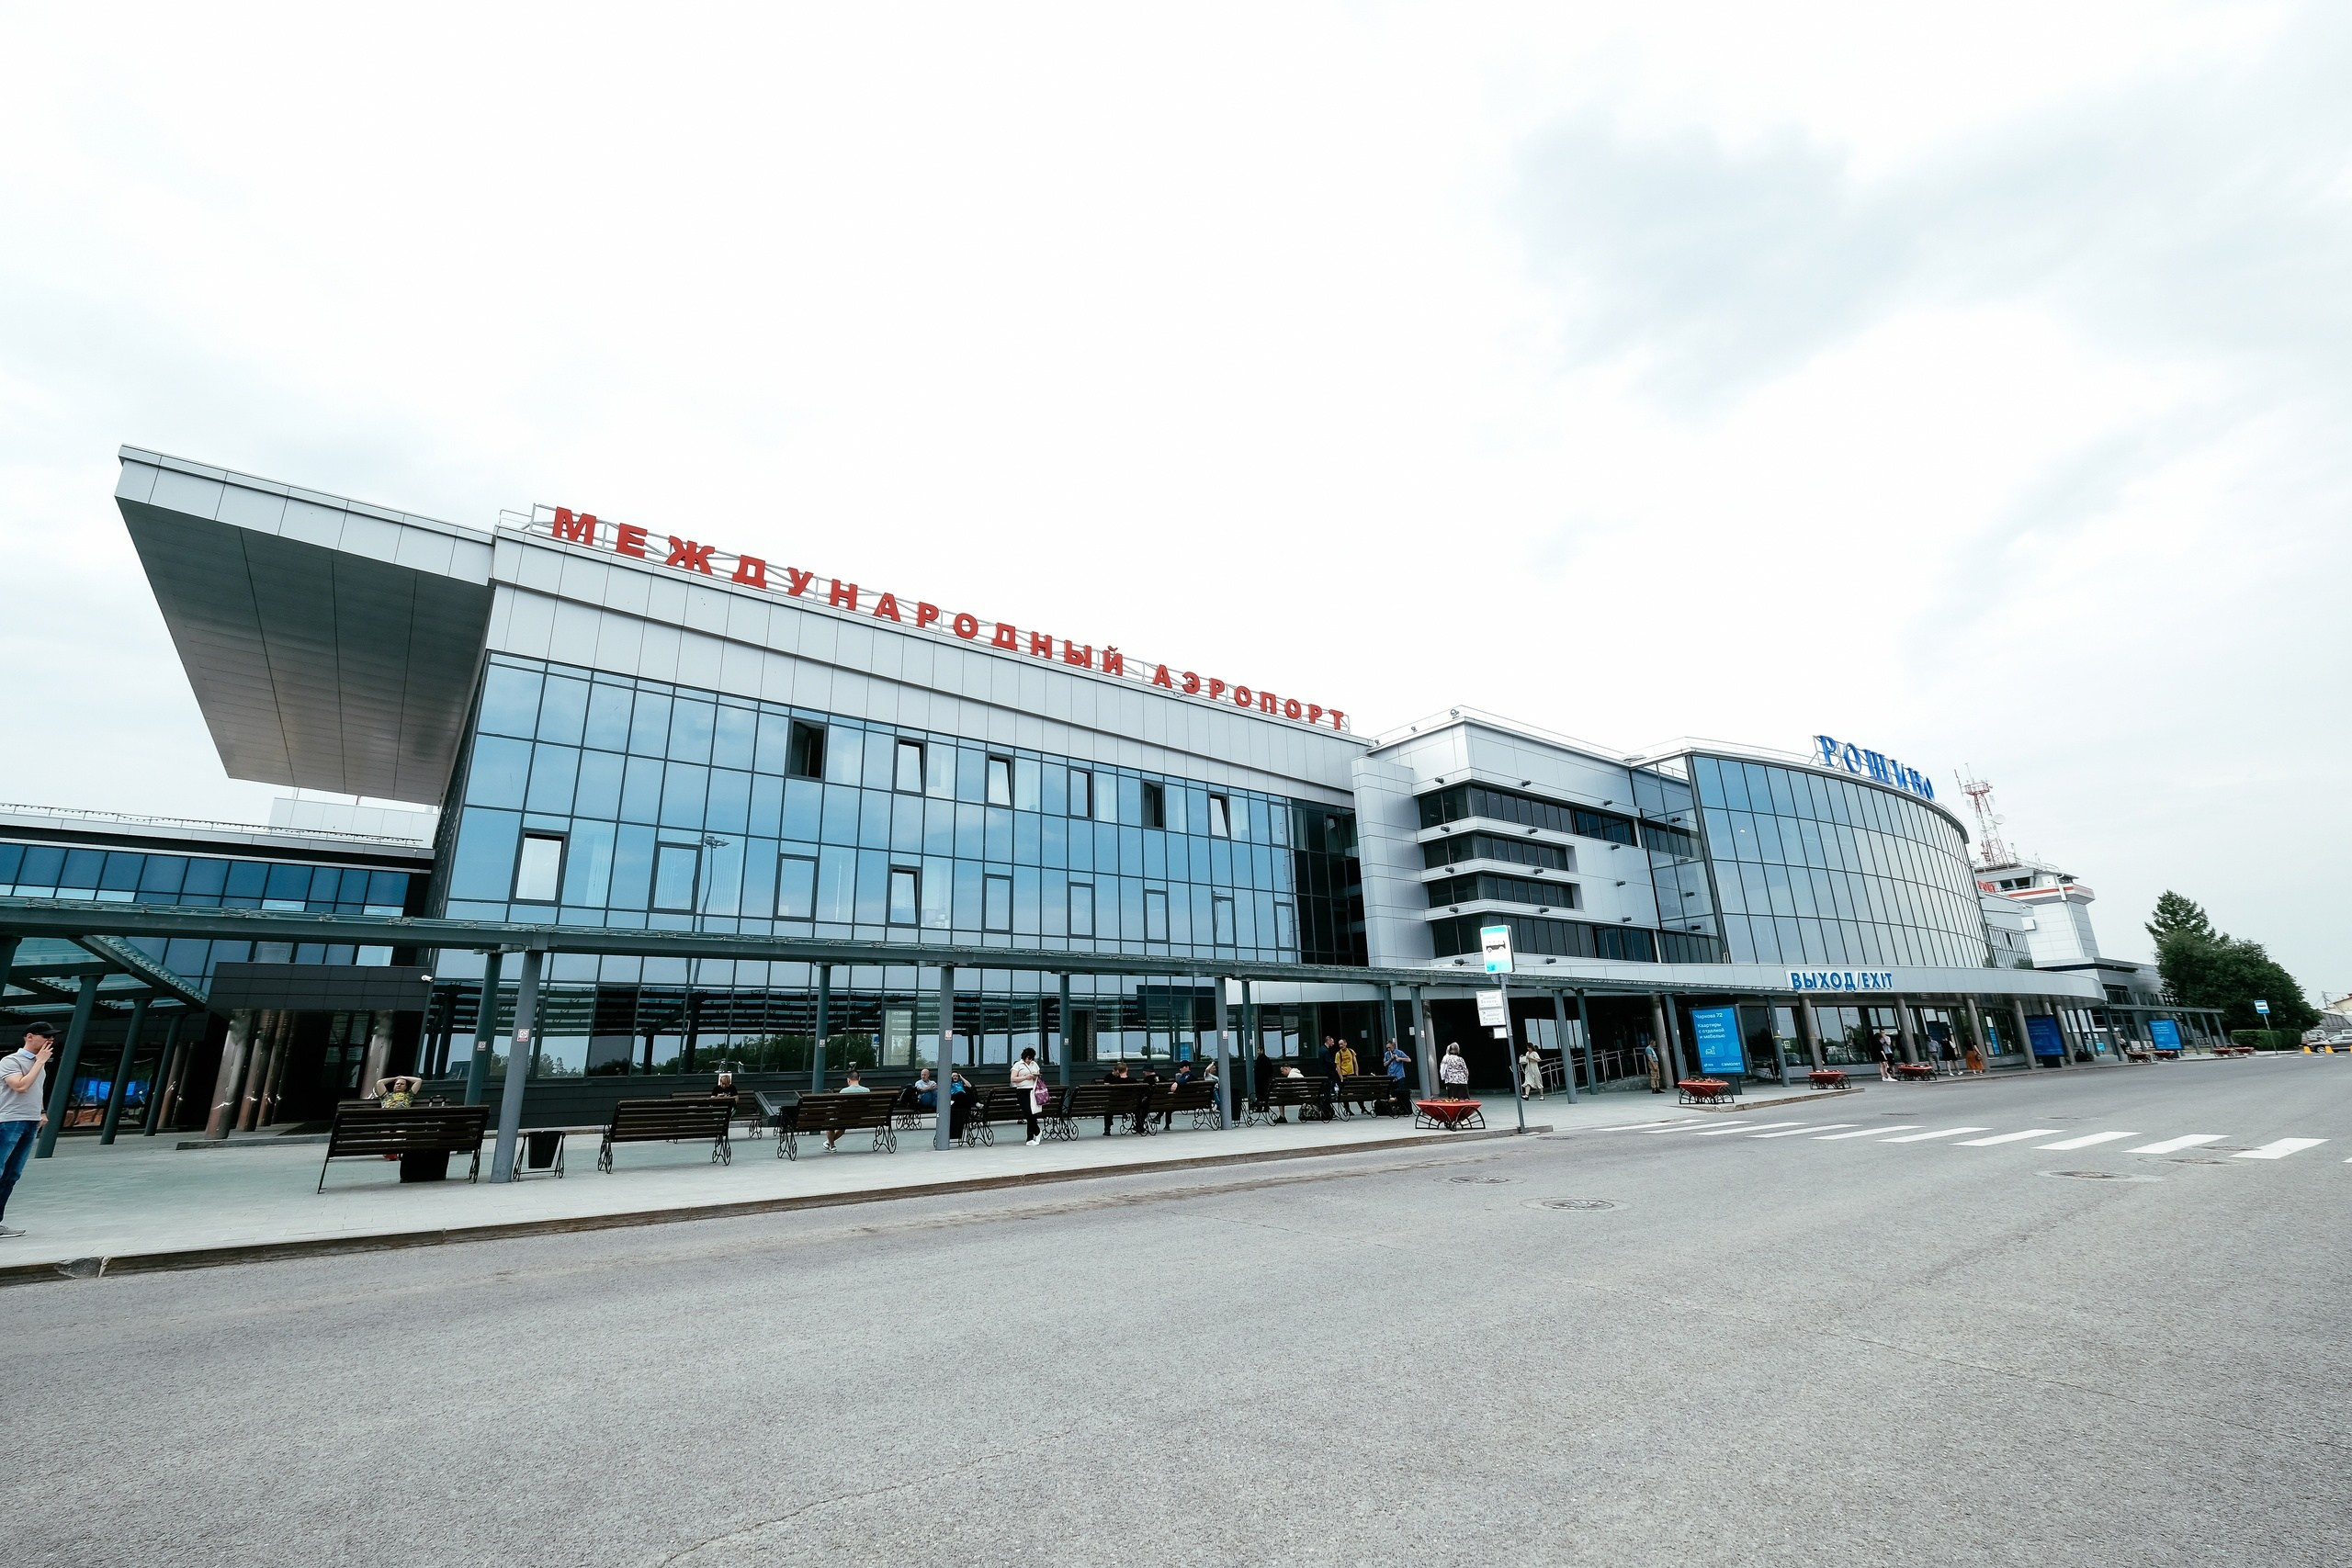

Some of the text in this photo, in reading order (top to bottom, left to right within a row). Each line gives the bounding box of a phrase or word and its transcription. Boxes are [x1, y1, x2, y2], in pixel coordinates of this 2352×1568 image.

[552, 506, 1344, 730] МЕЖДУНАРОДНЫЙ АЭРОПОРТ
[1791, 972, 1893, 991] ВЫХОД/EXIT
